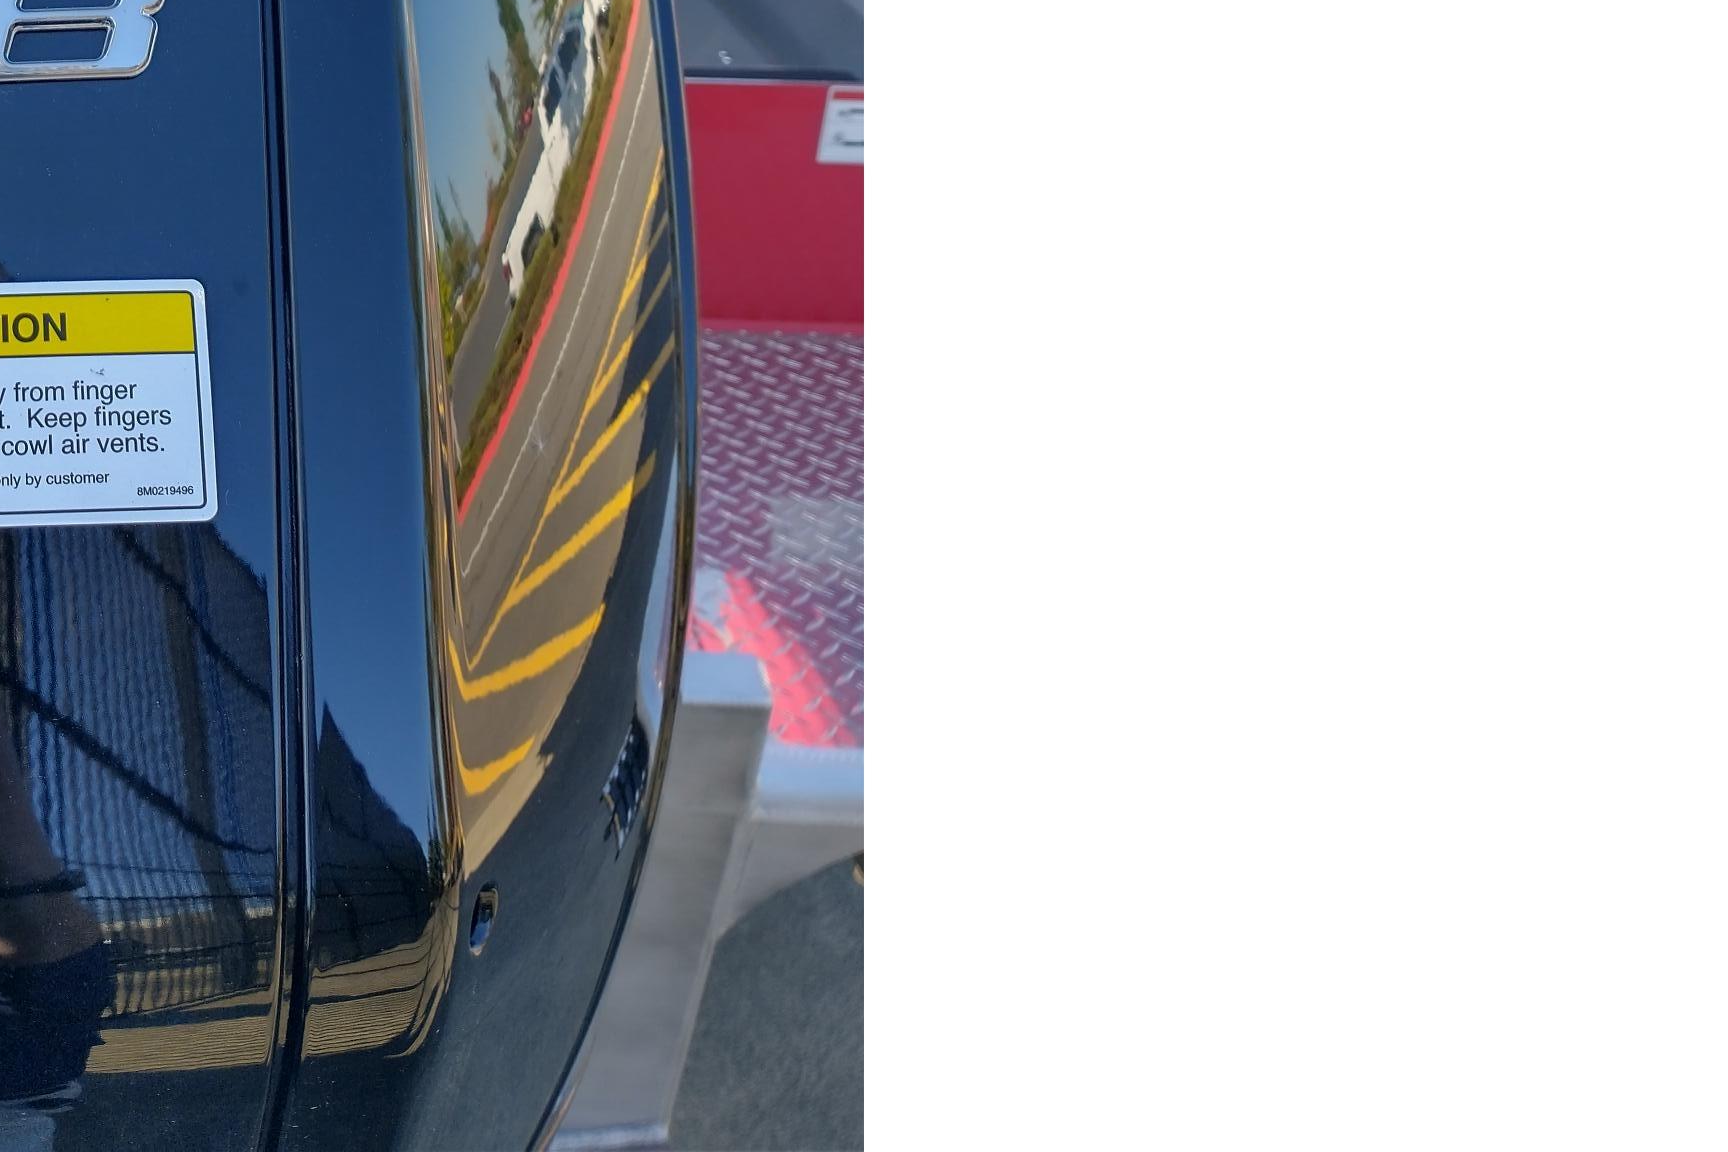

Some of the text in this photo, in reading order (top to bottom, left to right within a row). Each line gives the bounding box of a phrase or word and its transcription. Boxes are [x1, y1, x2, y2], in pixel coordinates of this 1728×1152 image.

[13, 382, 65, 402] from
[71, 380, 138, 405] finger
[27, 407, 87, 432] Keep
[93, 406, 172, 431] fingers
[1, 434, 54, 456] cowl
[61, 433, 90, 455] air
[96, 433, 165, 454] vents.
[25, 472, 42, 488] by
[46, 471, 110, 485] customer
[136, 485, 195, 497] 8M0219496
